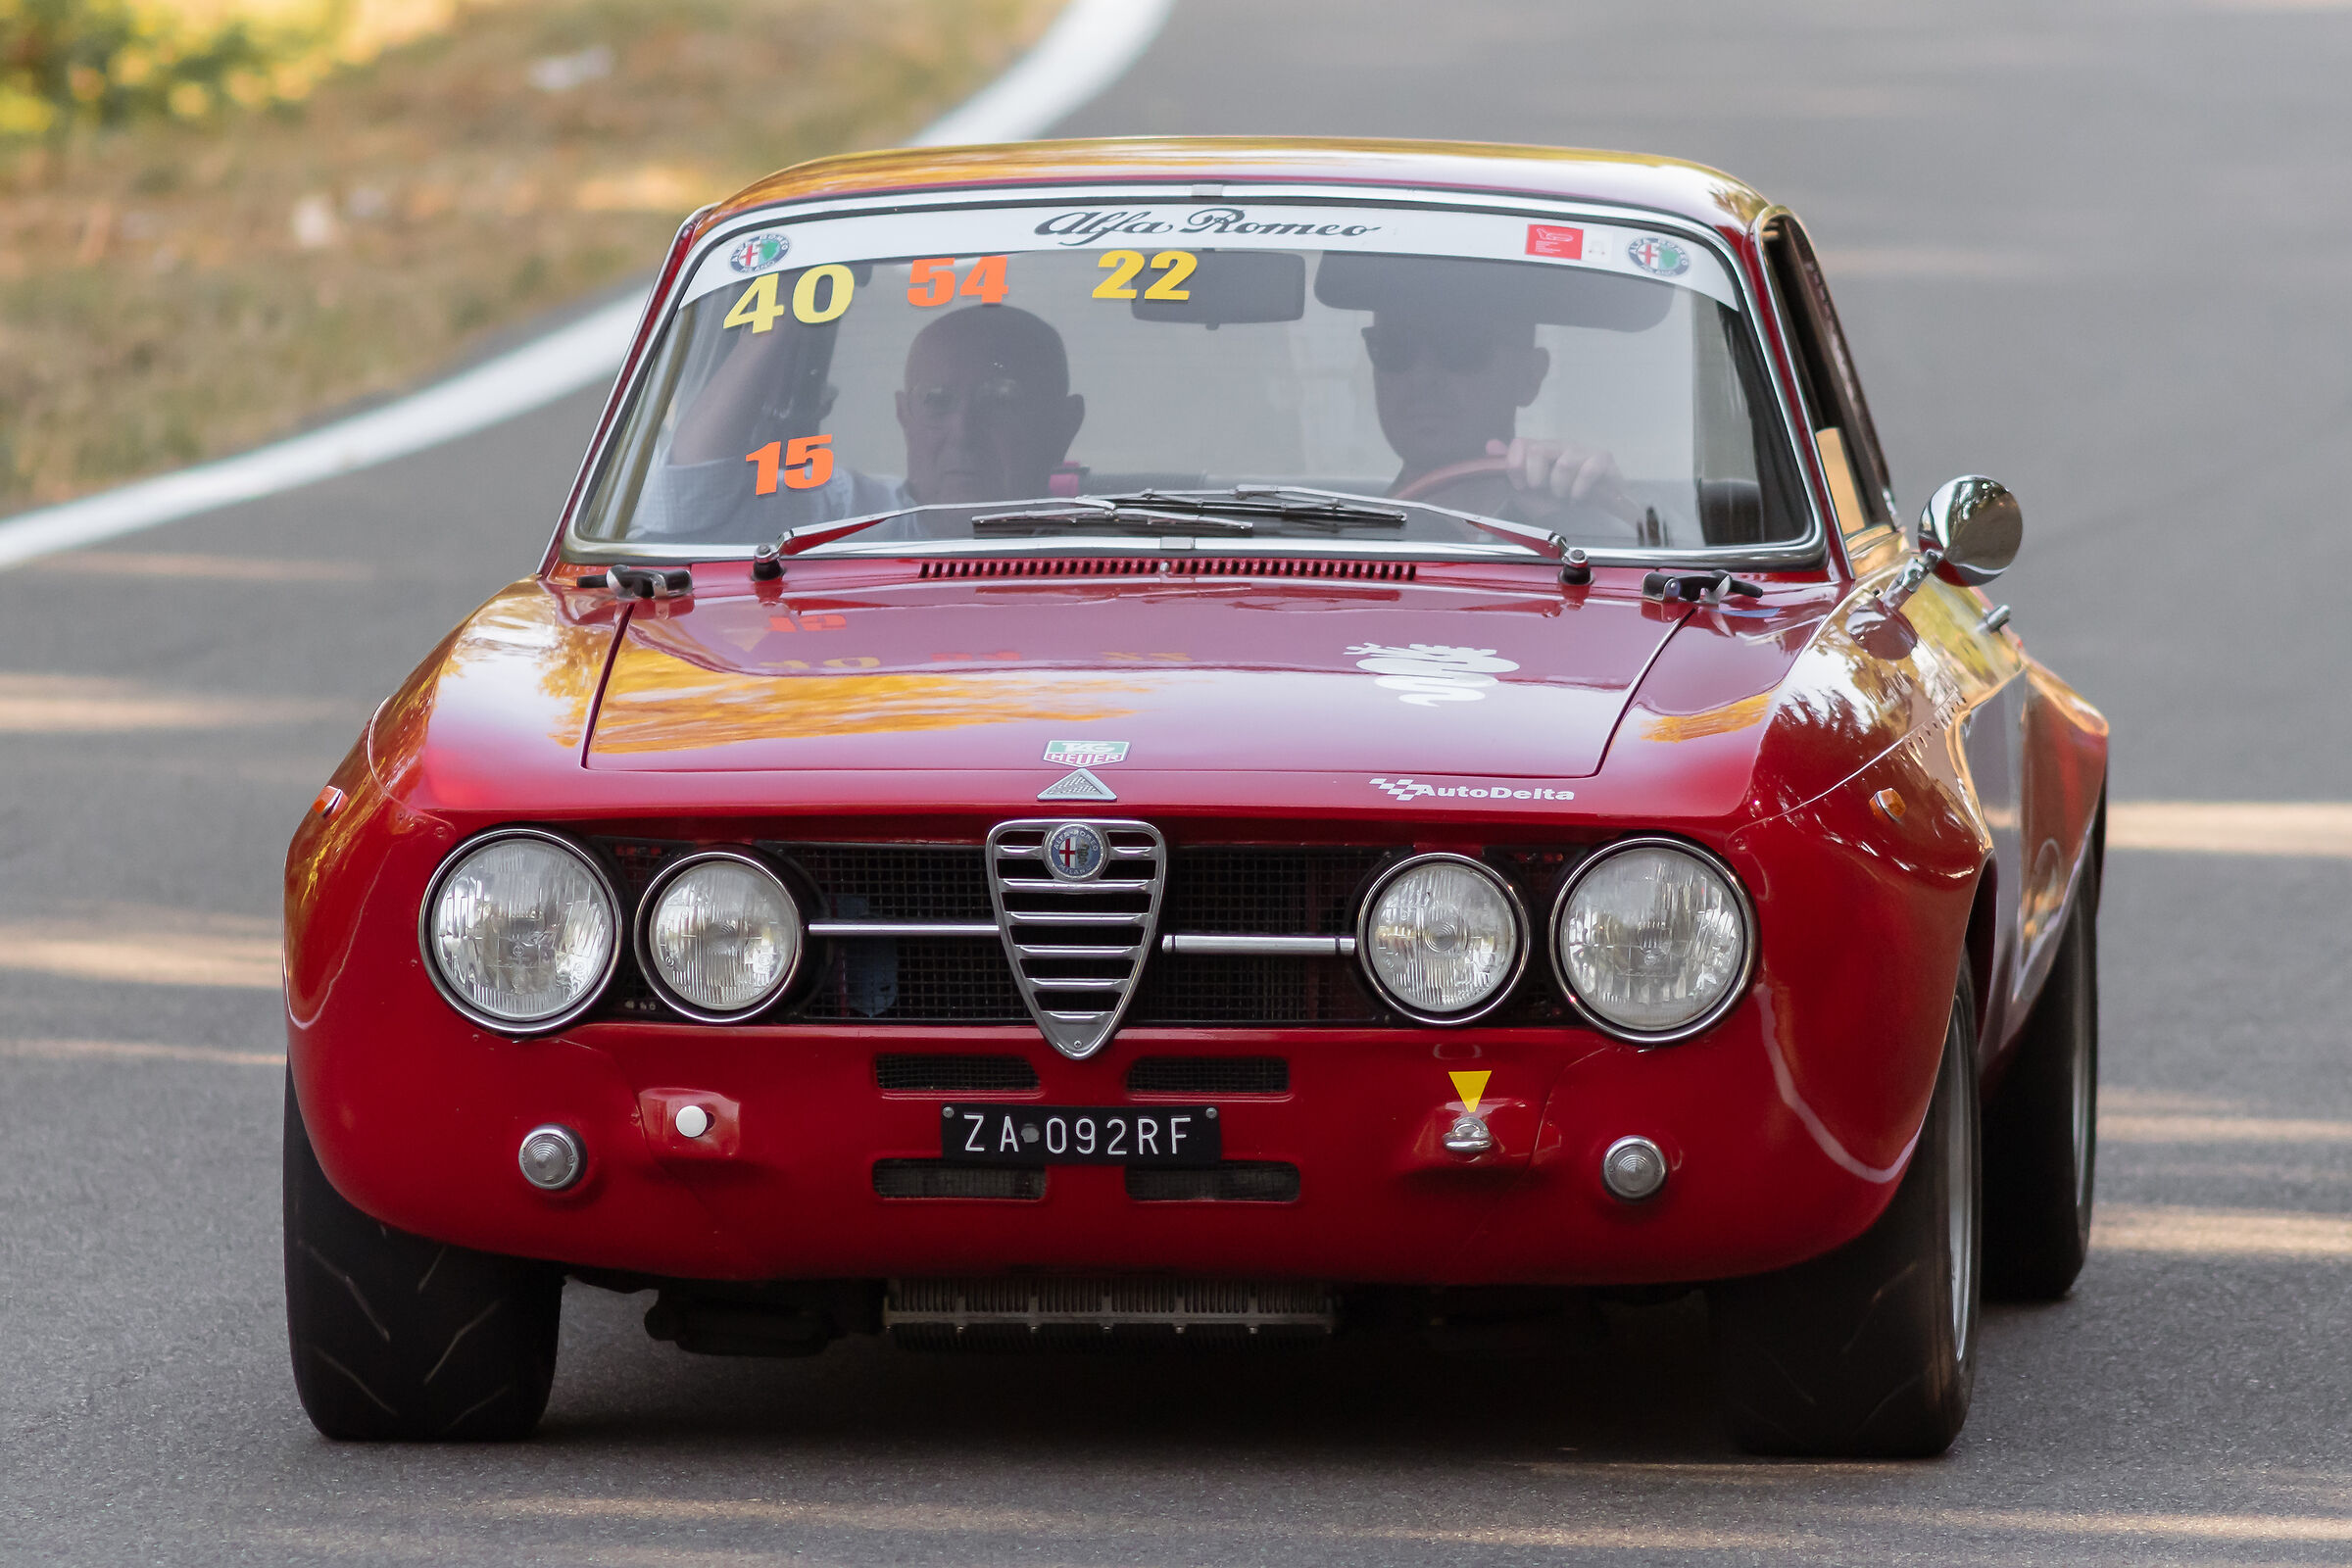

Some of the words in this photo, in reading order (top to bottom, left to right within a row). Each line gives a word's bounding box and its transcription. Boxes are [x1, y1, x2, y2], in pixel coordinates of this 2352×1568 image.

[1034, 211, 1173, 246] Alfa
[1179, 208, 1382, 237] Romeo
[907, 256, 1008, 307] 54
[1092, 250, 1198, 301] 22
[723, 265, 855, 333] 40
[746, 434, 833, 495] 15
[1050, 753, 1121, 765] HEUER
[1062, 742, 1115, 754] TAG
[1413, 784, 1575, 801] AutoDelta
[963, 1114, 1020, 1152] ZA
[1046, 1116, 1192, 1155] 092RF
